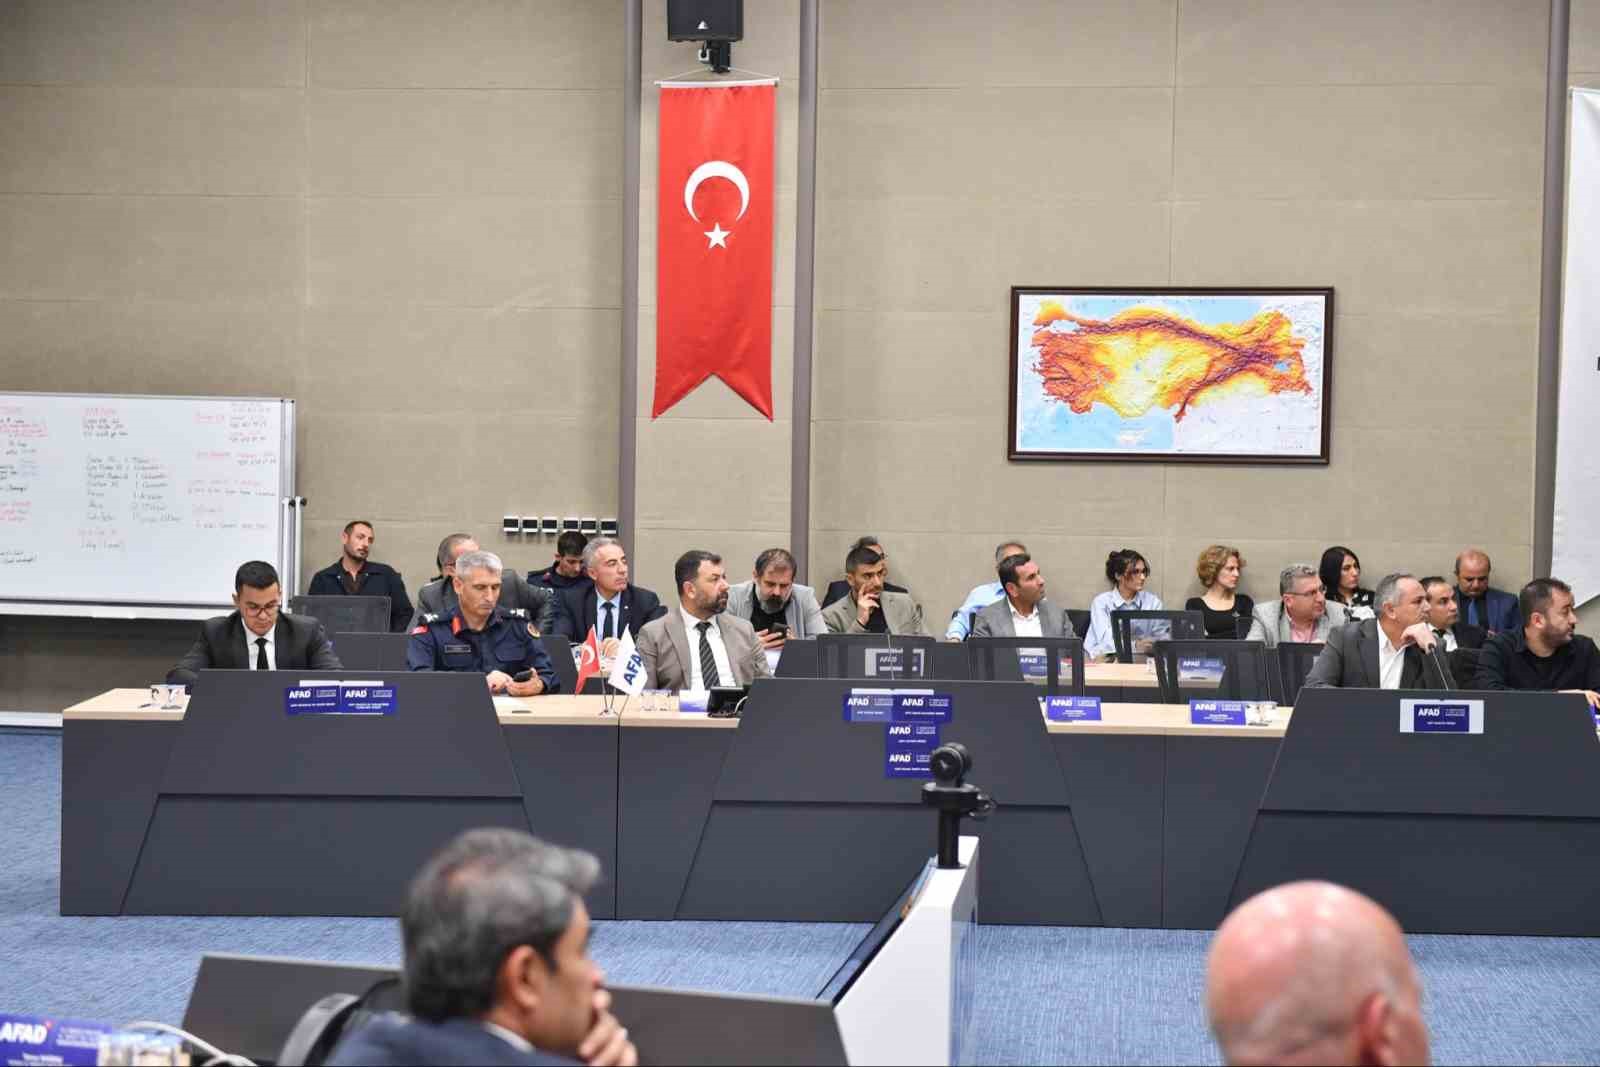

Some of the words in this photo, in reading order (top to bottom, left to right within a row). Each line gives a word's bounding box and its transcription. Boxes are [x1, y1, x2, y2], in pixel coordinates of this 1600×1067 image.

[289, 690, 311, 699] AFAD
[345, 690, 367, 699] AFAD
[848, 698, 870, 707] AFAD
[902, 698, 924, 707] AFAD
[1051, 699, 1073, 707] AFAD
[1195, 703, 1217, 711] AFAD
[1418, 708, 1440, 717] AFAD
[889, 726, 911, 735] AFAD
[889, 754, 911, 763] AFAD
[0, 1021, 48, 1045] AFAD
